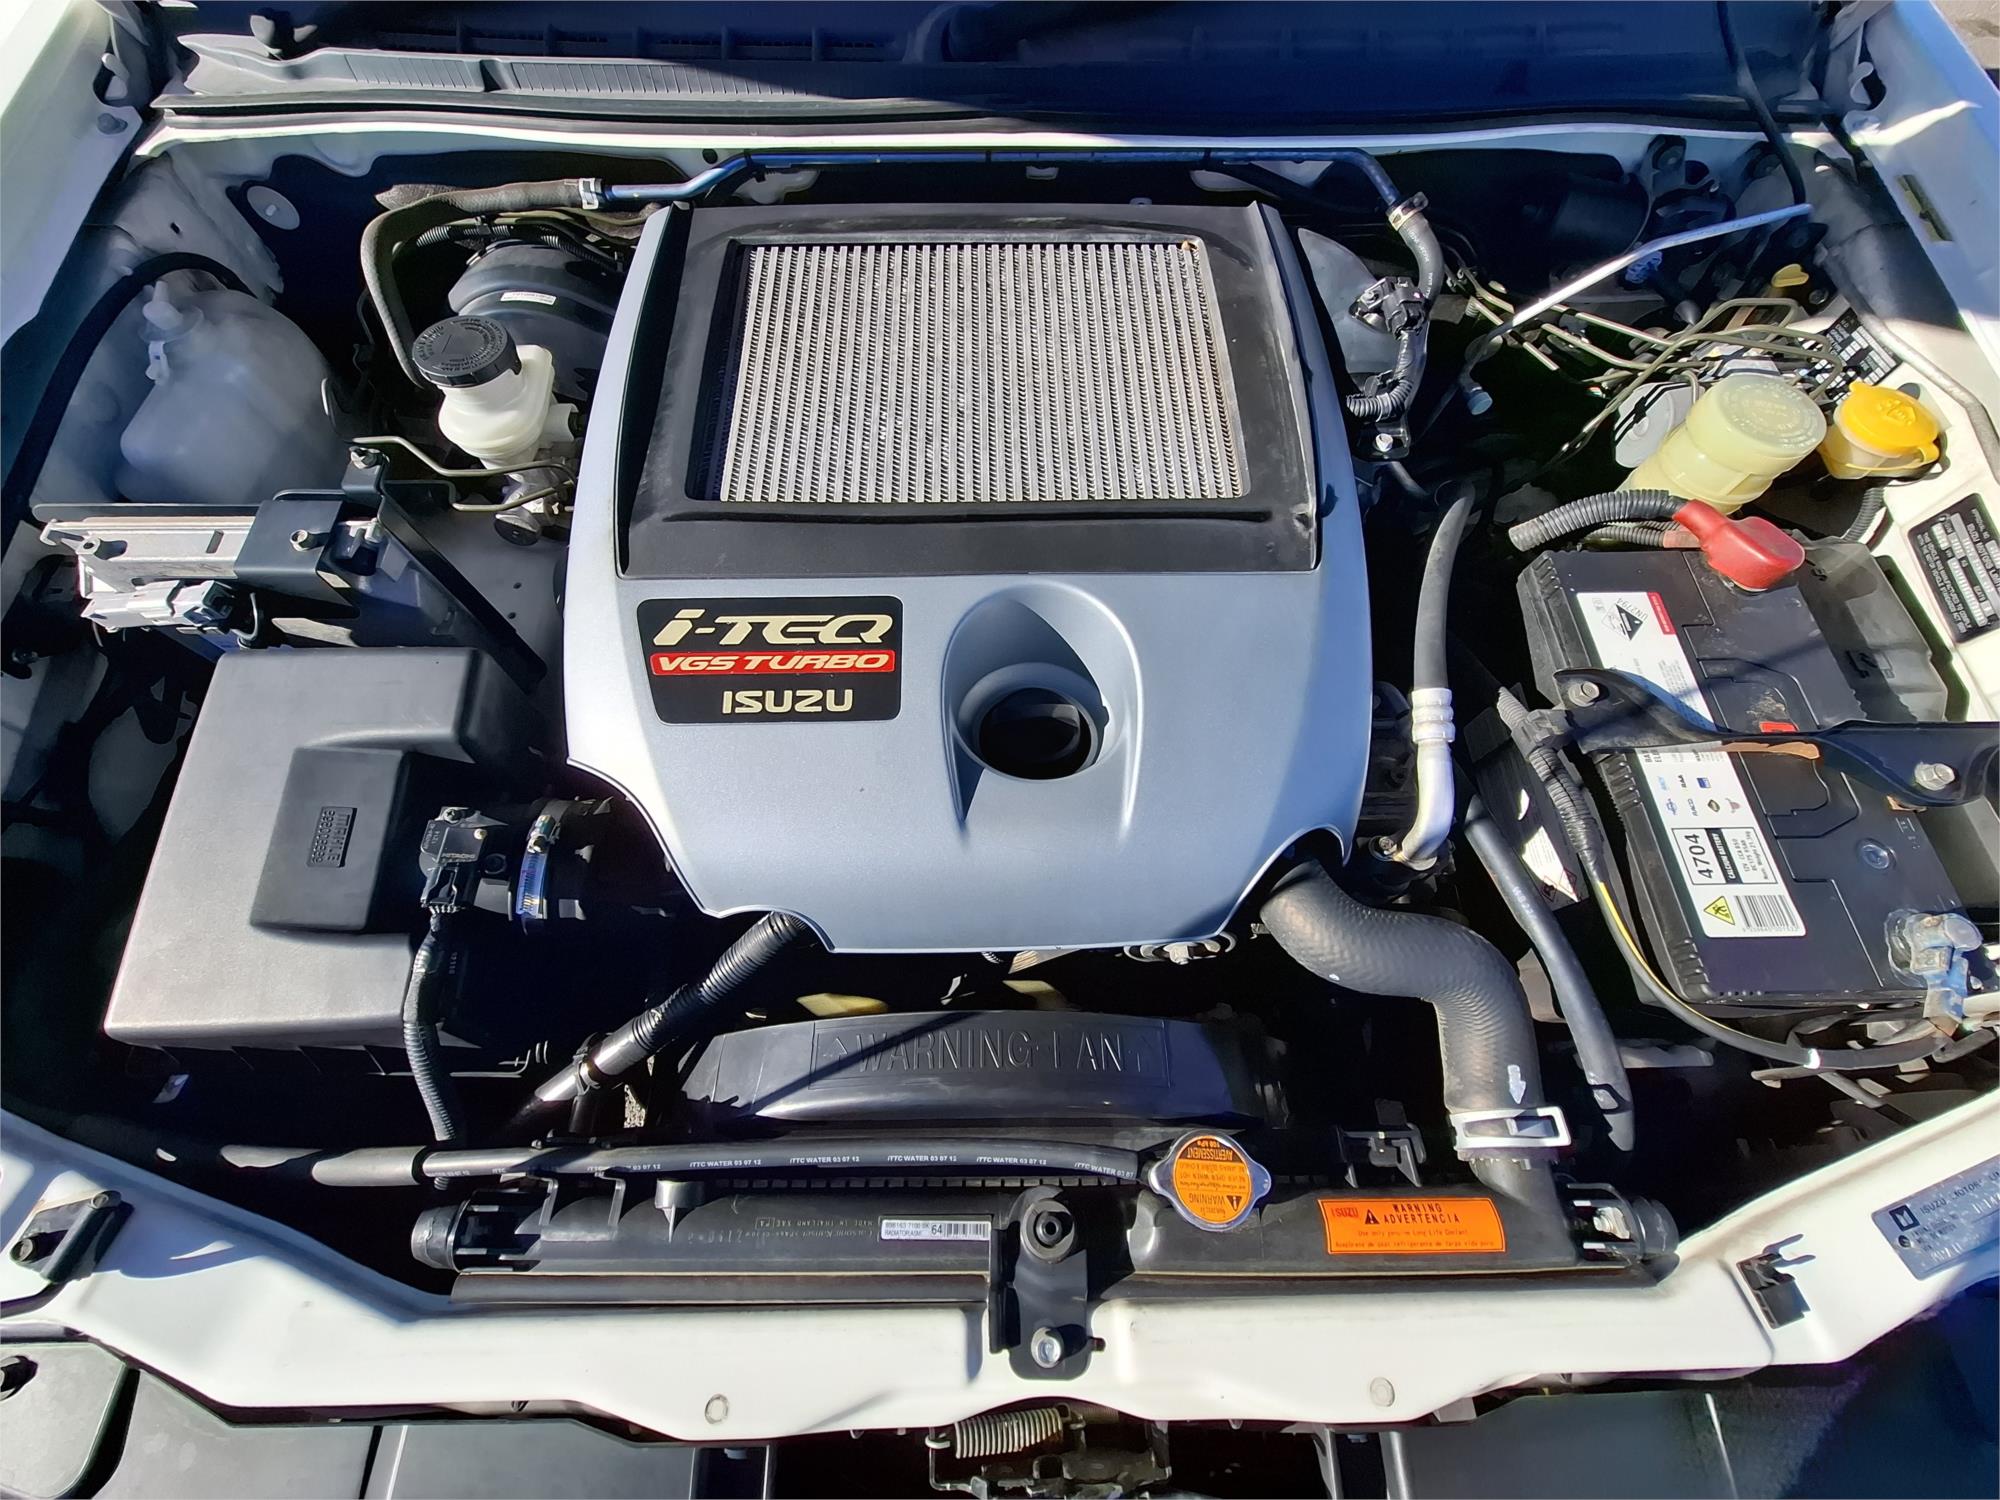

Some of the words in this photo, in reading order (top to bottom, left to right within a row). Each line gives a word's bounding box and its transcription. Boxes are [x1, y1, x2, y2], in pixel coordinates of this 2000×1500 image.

[1965, 522, 1980, 542] ISUZU
[1974, 541, 1994, 569] MOTORS
[658, 655, 741, 671] VGS
[743, 653, 889, 671] TURBO
[722, 689, 853, 714] ISUZU
[1711, 832, 1726, 854] BATTERY
[1683, 833, 1713, 878] 4704
[1736, 850, 1744, 859] CCA
[1720, 855, 1735, 878] CALCIUM
[1741, 863, 1750, 871] 12V
[855, 1029, 1031, 1073] WARNING
[1090, 1165, 1116, 1175] WATER
[1331, 1207, 1359, 1218] ISUZU
[1392, 1204, 1442, 1213] WARNING
[1919, 1196, 1947, 1215] ISUZU
[1383, 1213, 1460, 1224] ADVERTENCIA
[931, 1224, 941, 1234] 64
